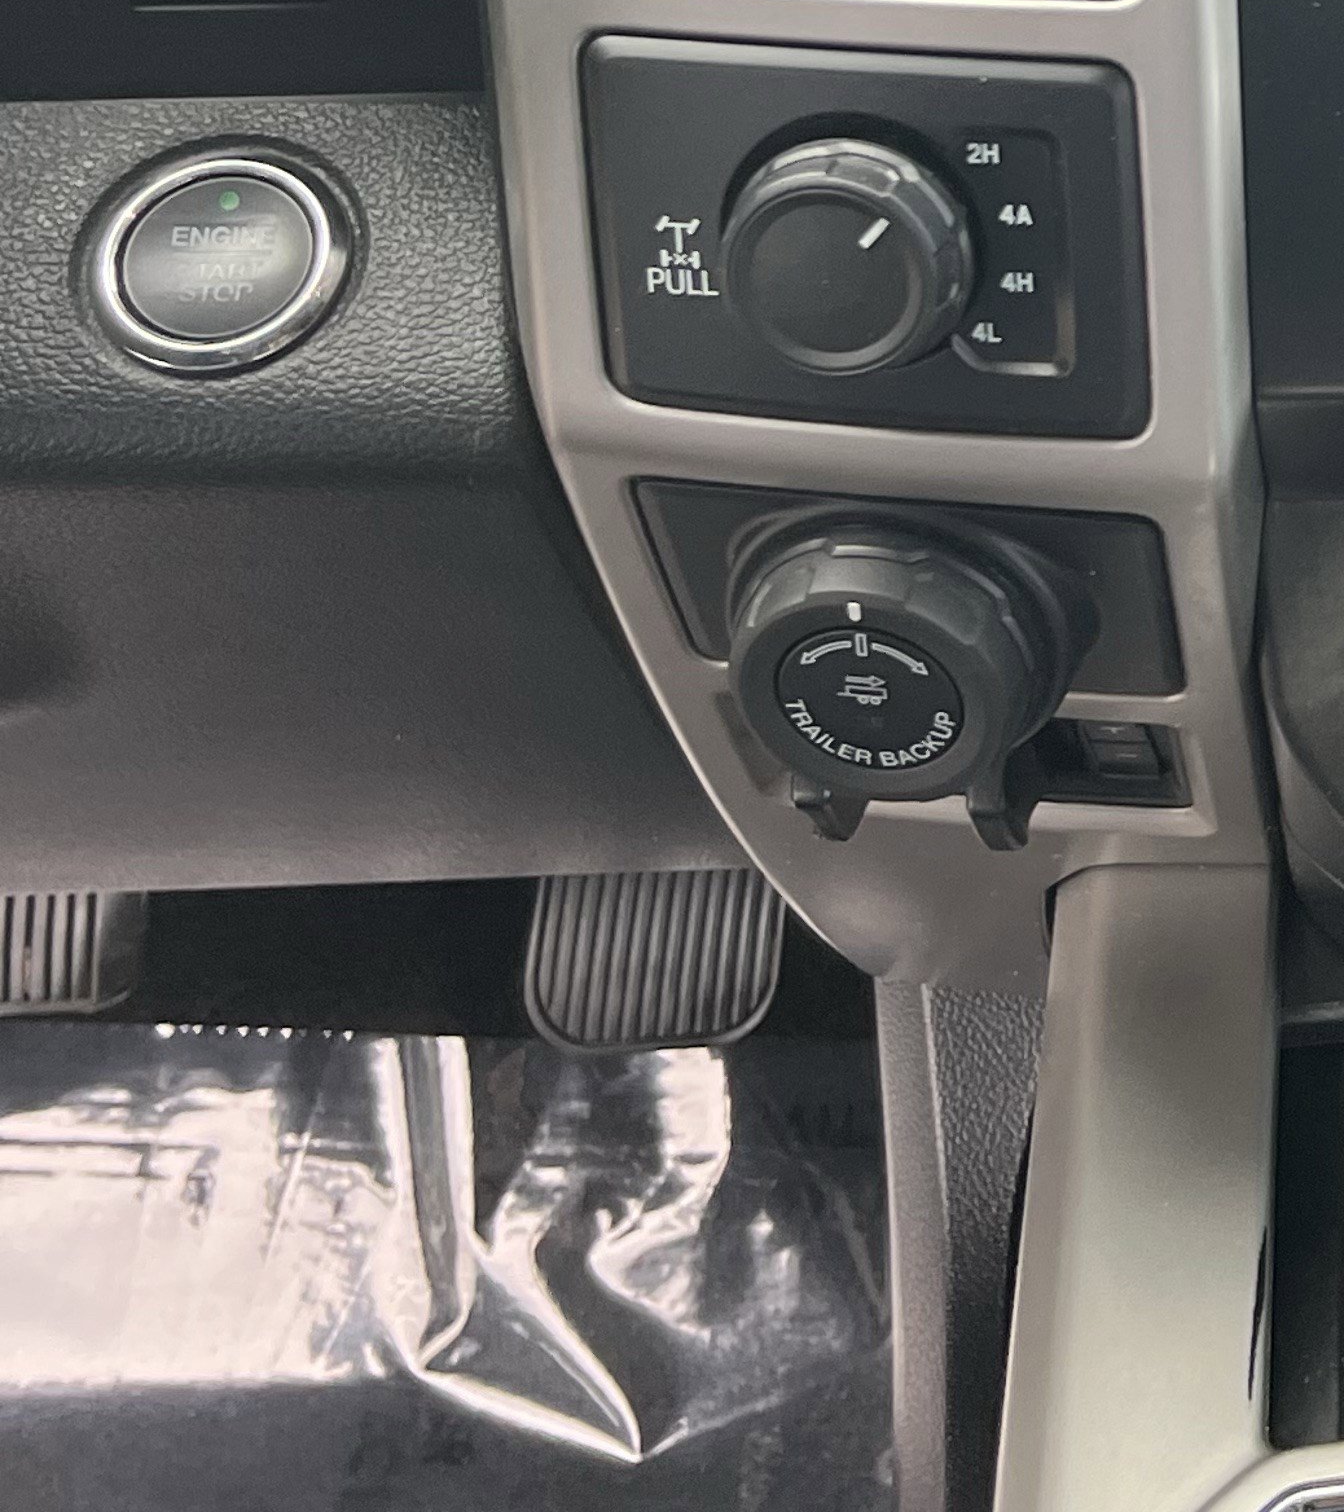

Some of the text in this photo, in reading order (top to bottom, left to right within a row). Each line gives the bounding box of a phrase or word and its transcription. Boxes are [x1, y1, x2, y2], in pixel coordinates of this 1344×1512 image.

[966, 143, 1001, 166] 2H
[999, 204, 1034, 227] 4A
[170, 225, 277, 248] ENGINE
[645, 267, 720, 297] PULL
[1000, 272, 1035, 294] 4H
[970, 322, 1003, 344] 4L
[784, 698, 957, 768] TRAILER BACKUP
